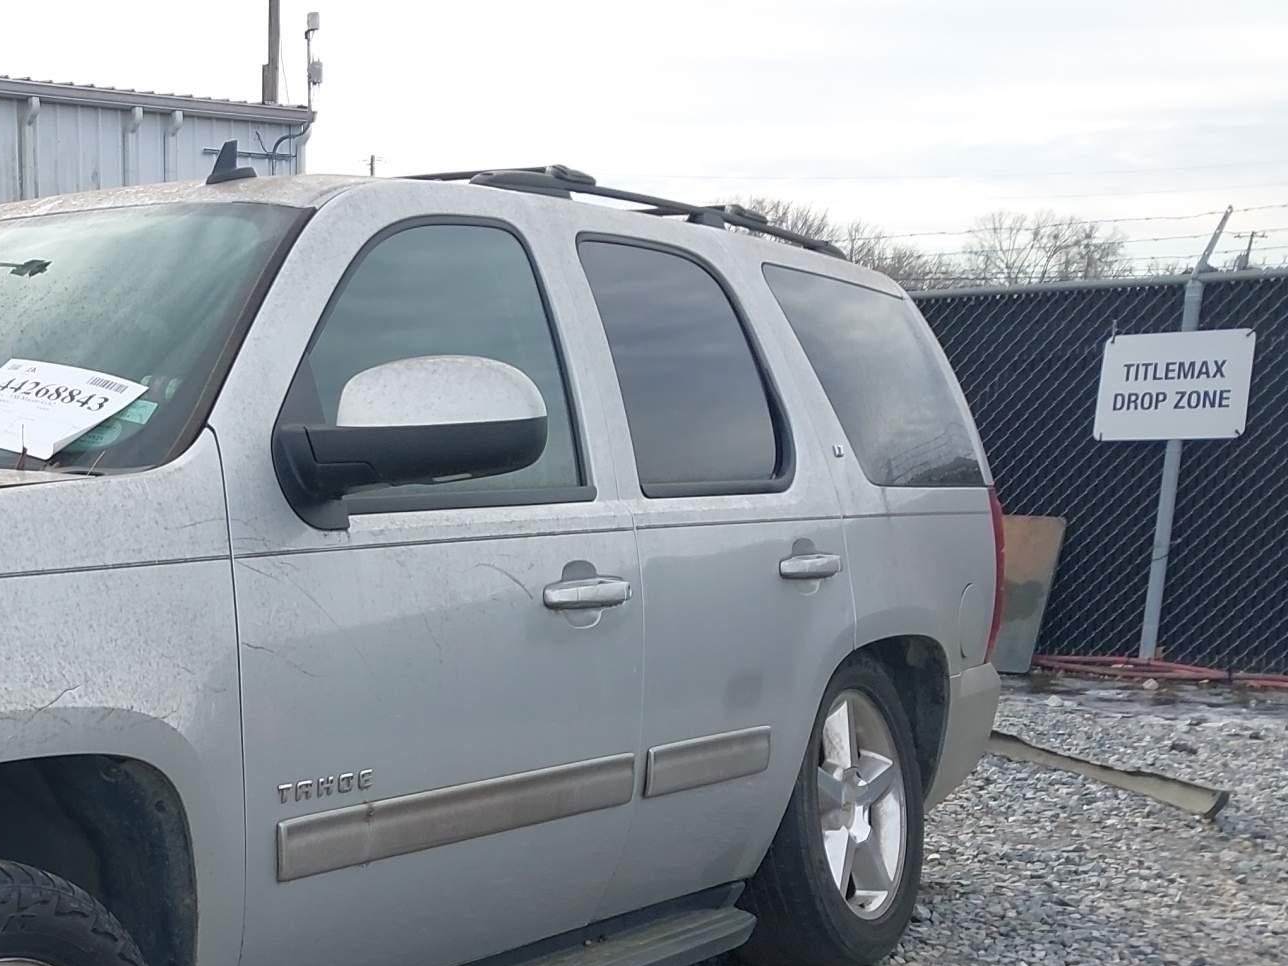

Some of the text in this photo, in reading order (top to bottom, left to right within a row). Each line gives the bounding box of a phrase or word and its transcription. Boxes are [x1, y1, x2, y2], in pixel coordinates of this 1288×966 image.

[1123, 360, 1227, 382] TITLEMAX
[1112, 389, 1231, 411] DROP ZONE
[277, 768, 374, 804] TAHOE
